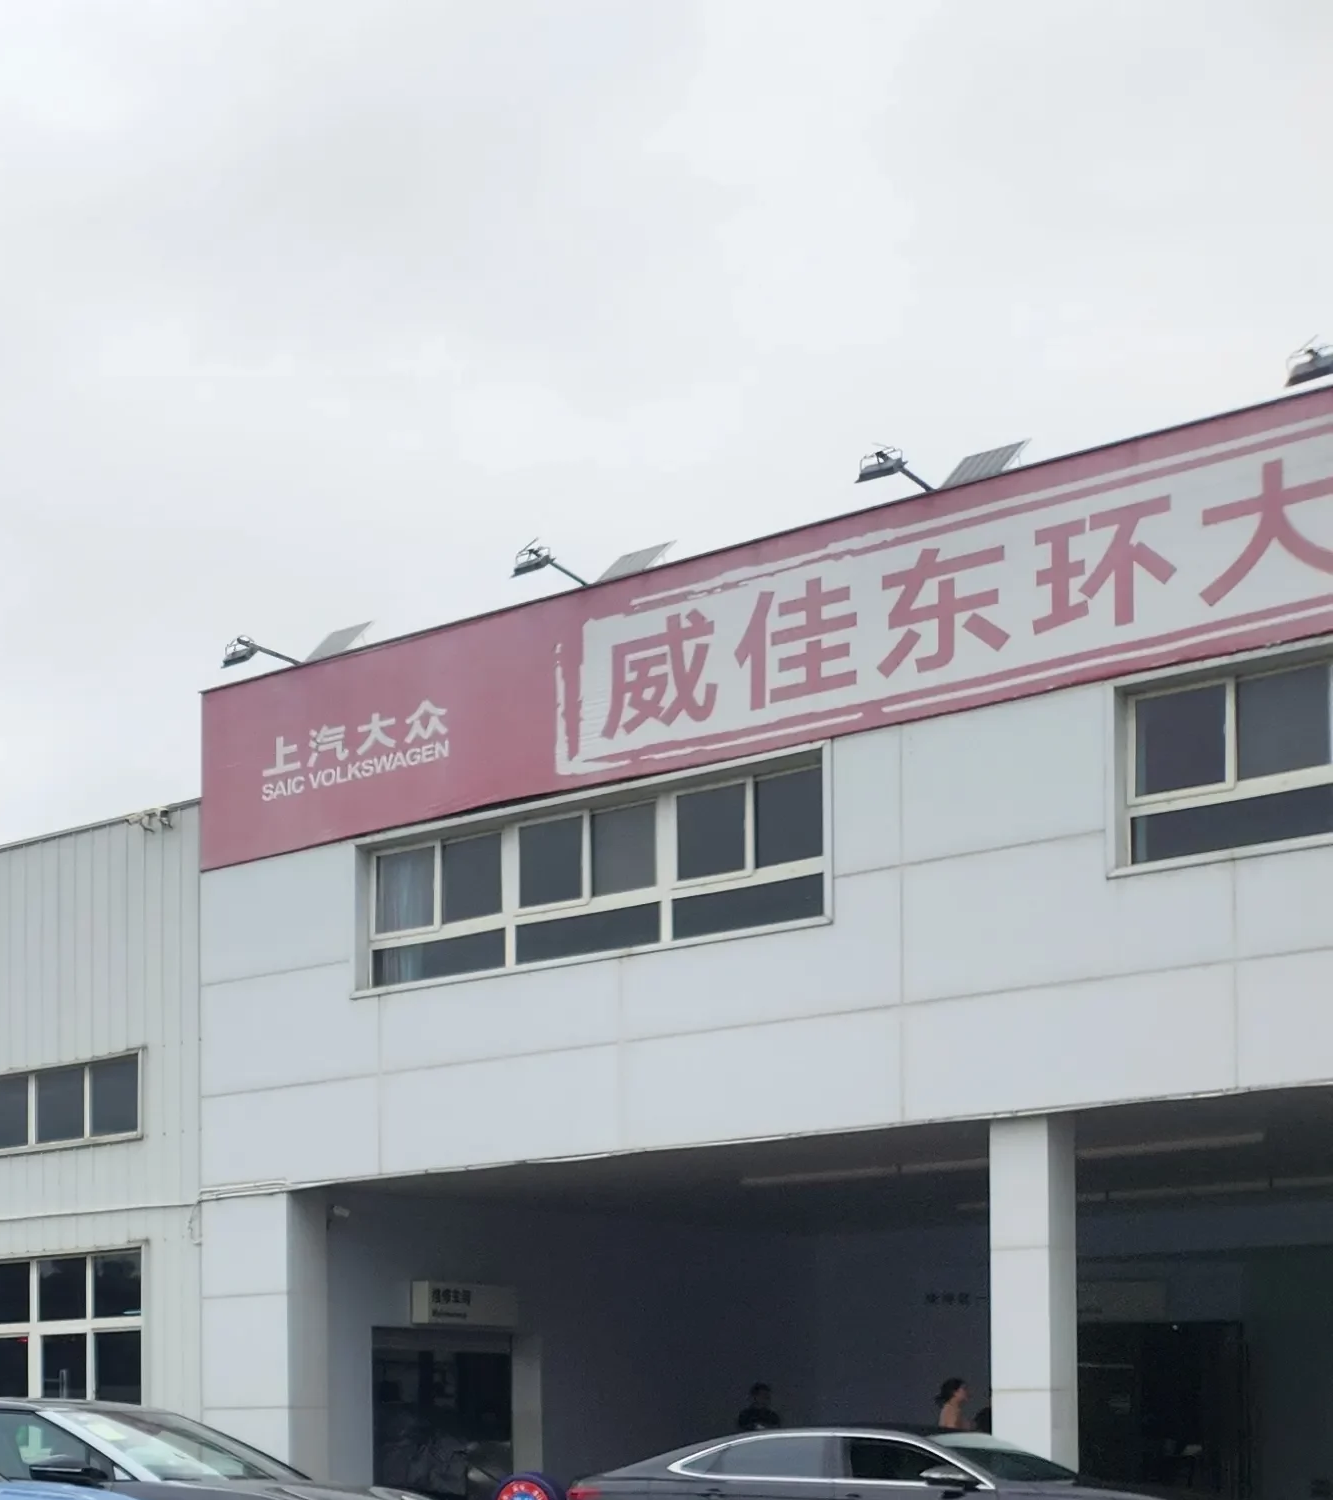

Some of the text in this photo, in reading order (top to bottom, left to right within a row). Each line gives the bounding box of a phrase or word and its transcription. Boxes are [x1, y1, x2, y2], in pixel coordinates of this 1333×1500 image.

[601, 458, 1333, 741] 威佳东环大
[261, 699, 449, 778] 上汽大众
[261, 739, 450, 802] SAIC VOLKSWAGEN
